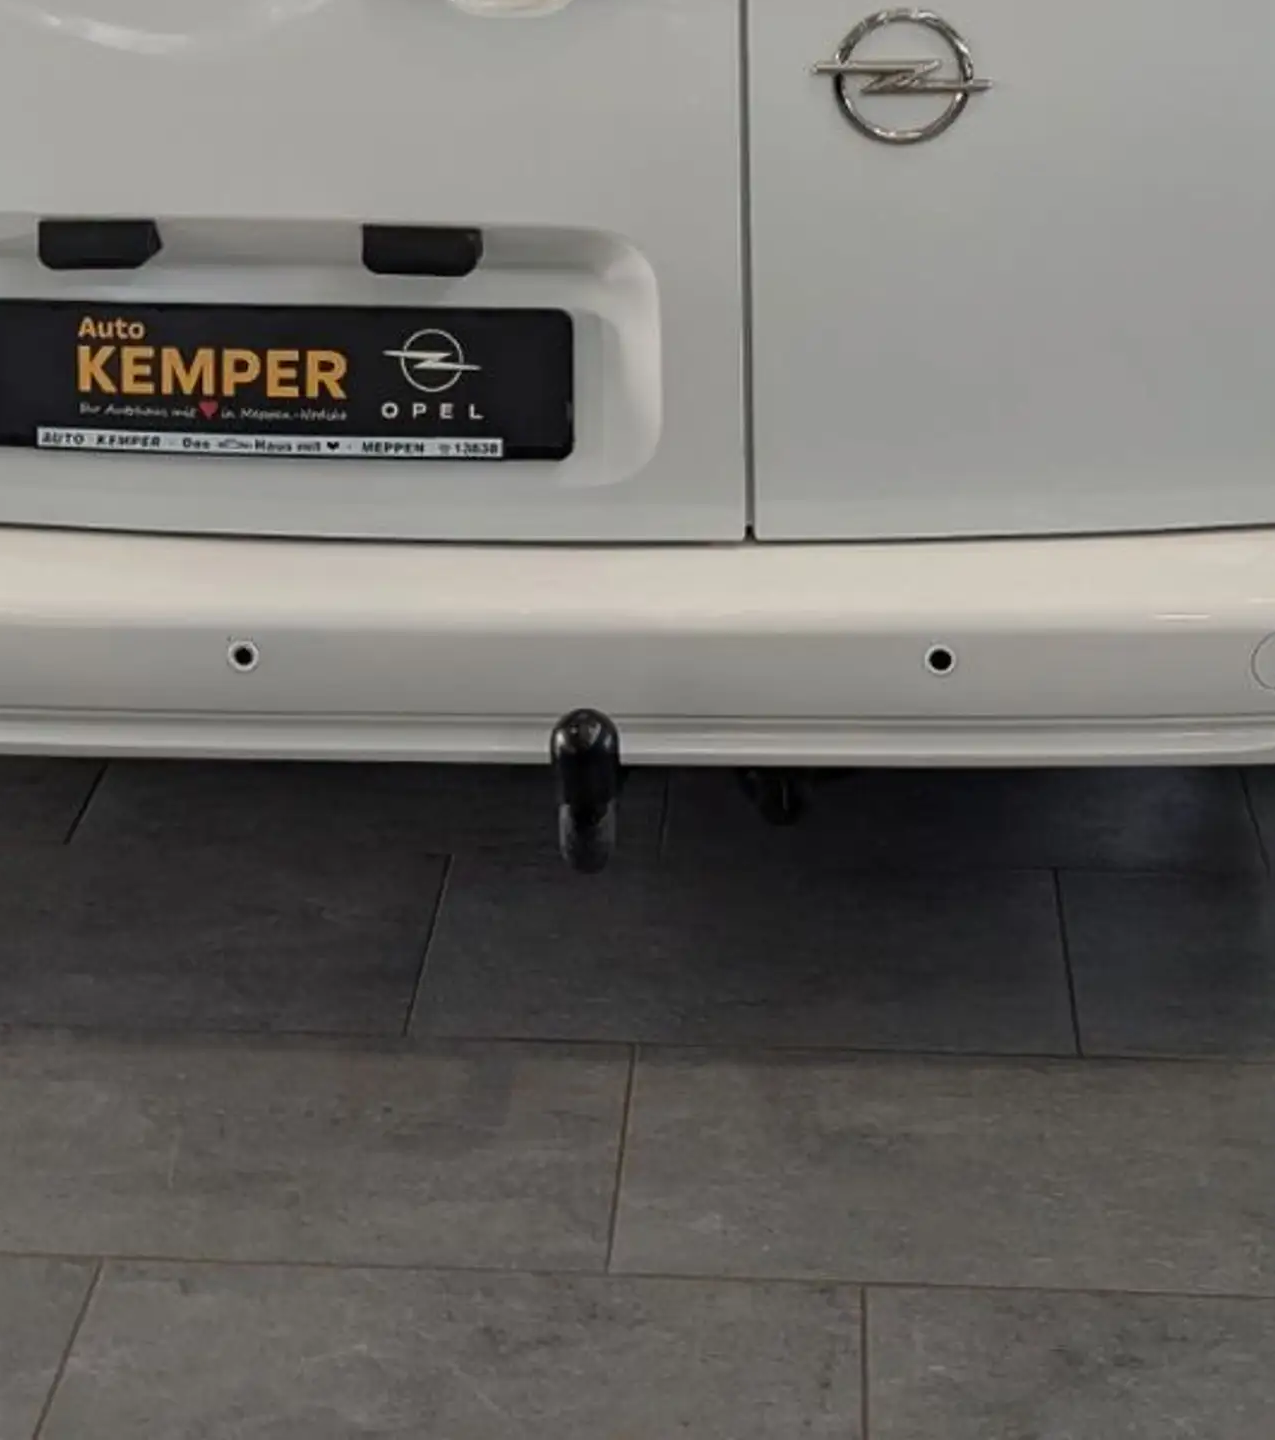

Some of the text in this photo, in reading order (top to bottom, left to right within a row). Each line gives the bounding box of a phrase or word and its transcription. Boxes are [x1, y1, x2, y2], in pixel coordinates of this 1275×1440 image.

[78, 316, 146, 339] Auto
[78, 345, 348, 400] KEMPER
[381, 402, 484, 420] OPEL
[41, 433, 85, 445] AUTO
[96, 435, 161, 448] KEMPER
[361, 441, 425, 454] MEPPEN
